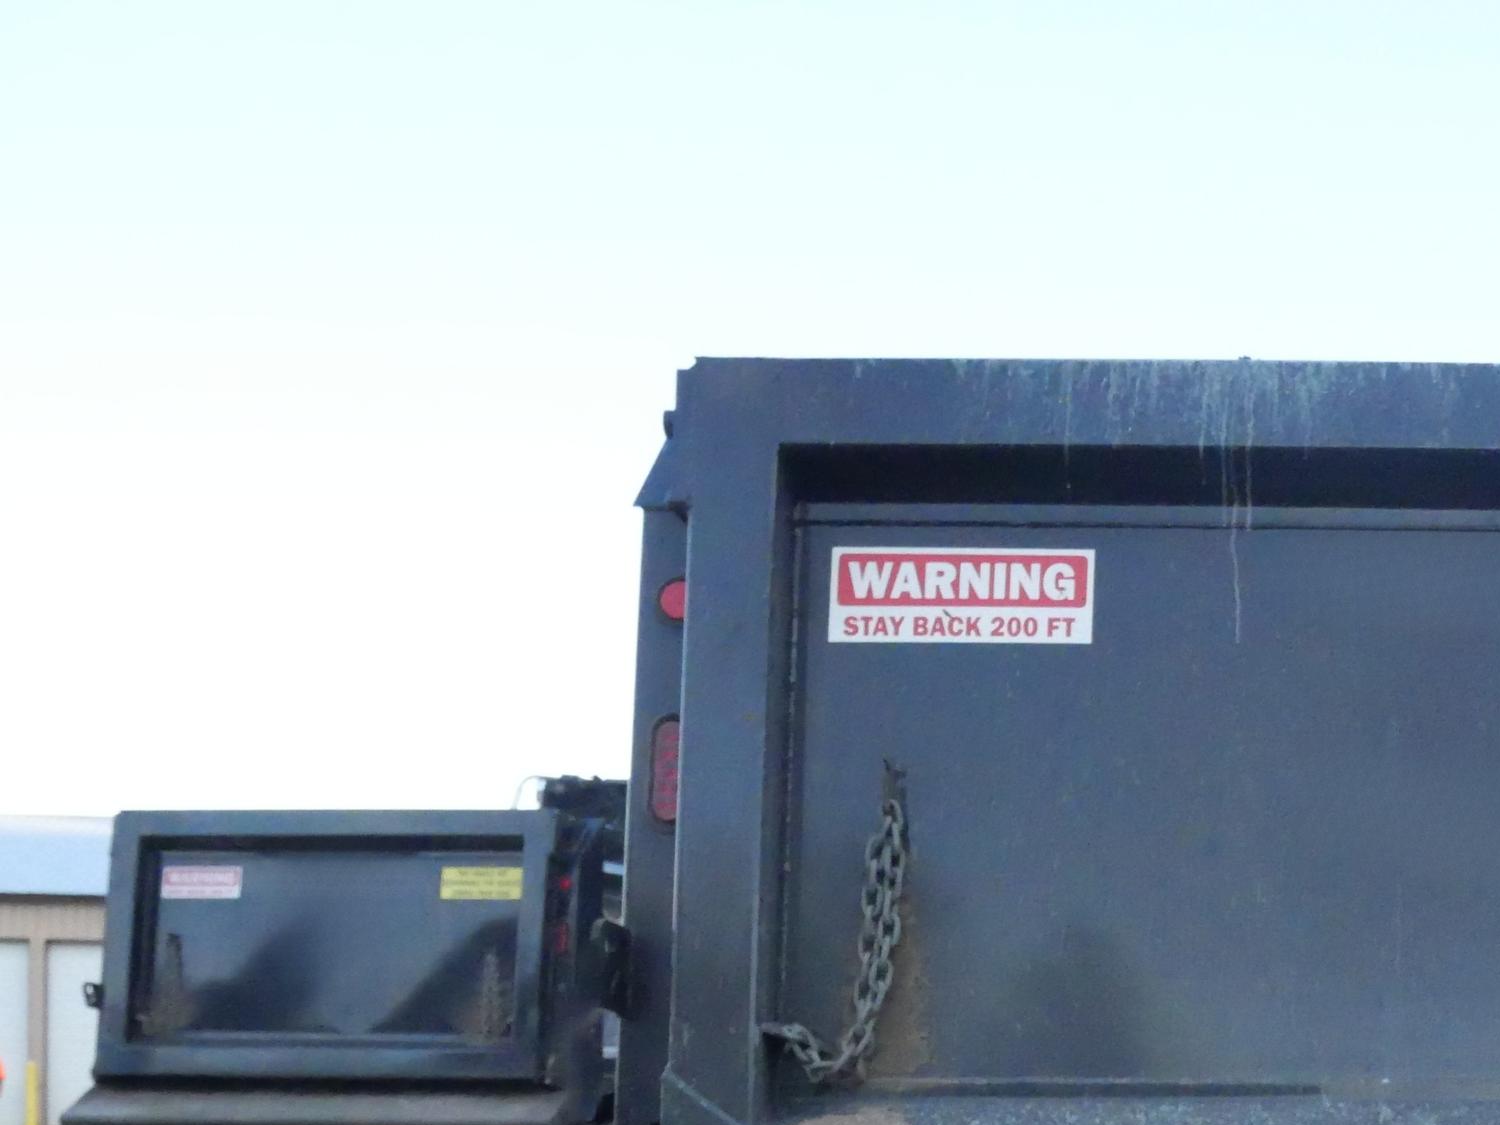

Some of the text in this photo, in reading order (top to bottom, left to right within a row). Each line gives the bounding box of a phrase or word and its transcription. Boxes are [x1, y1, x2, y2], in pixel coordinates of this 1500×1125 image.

[848, 561, 1076, 601] WARNING
[843, 616, 1076, 637] STAY BACK 200 FT
